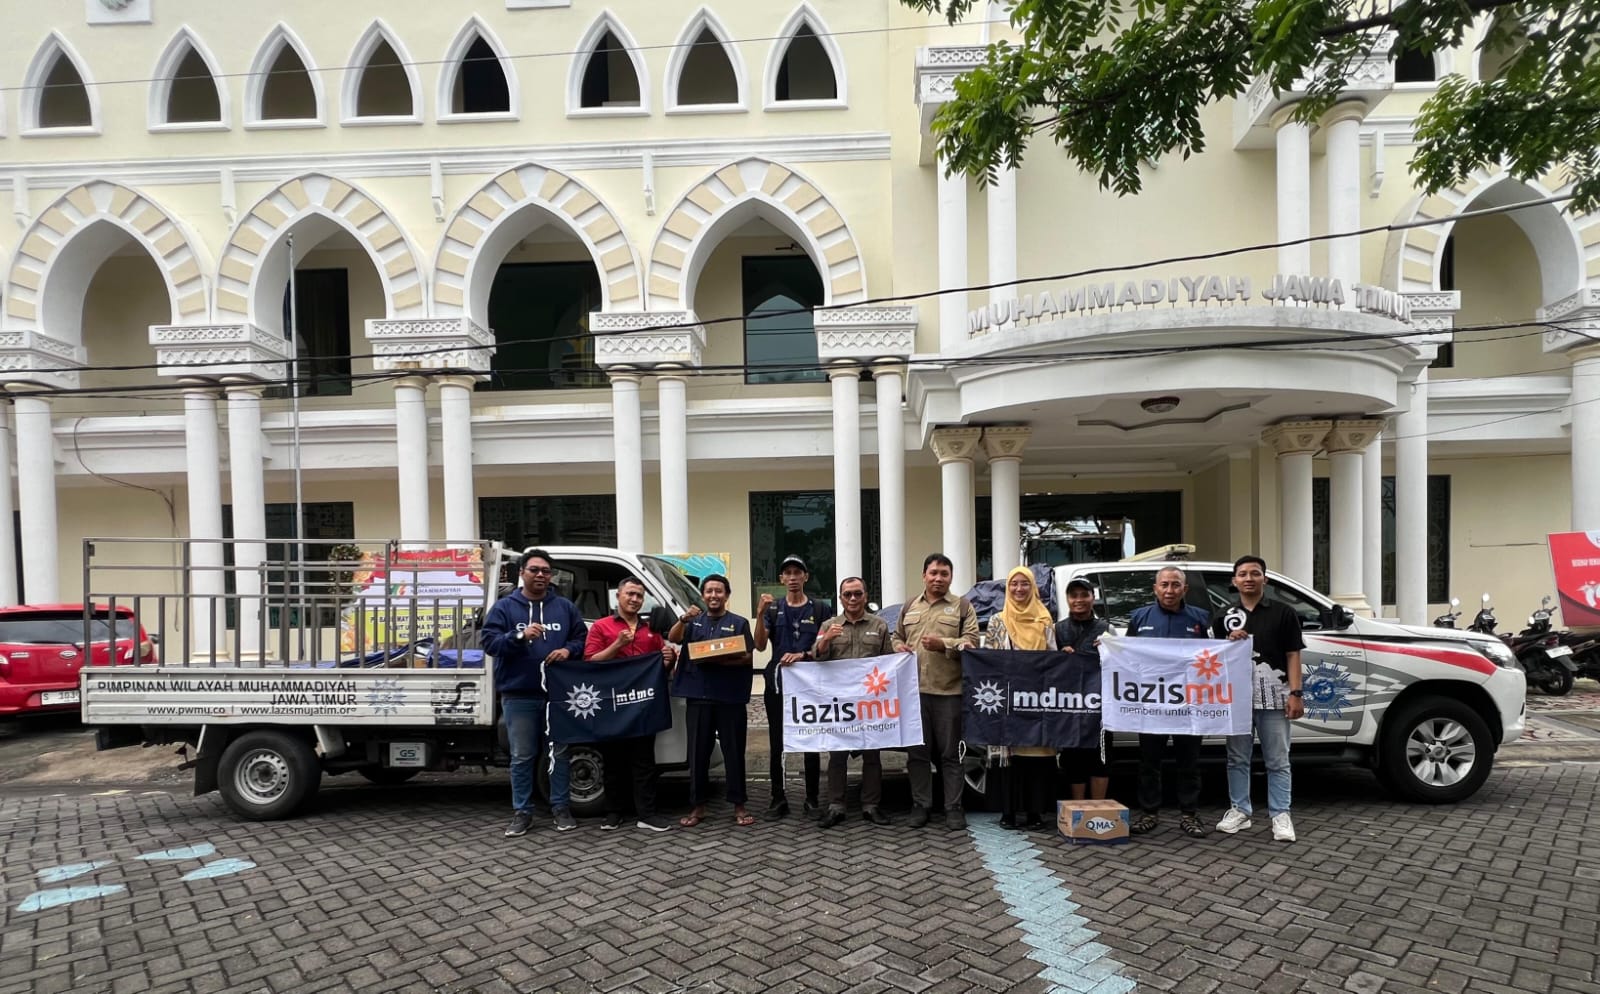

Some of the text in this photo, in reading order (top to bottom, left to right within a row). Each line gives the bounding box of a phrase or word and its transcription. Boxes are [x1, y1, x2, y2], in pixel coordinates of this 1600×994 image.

[968, 274, 1411, 333] MUHAMMADIYAH JAWA TIMUR
[98, 681, 356, 692] PIMPINAN WILAYAH MUHAMMADIYAH
[1113, 672, 1233, 704] lazismu
[43, 693, 49, 701] S
[270, 694, 357, 705] JAWA TIMUR
[616, 686, 655, 702] mdmc
[1013, 687, 1101, 709] mdmc
[147, 706, 225, 716] www.pwmu.co
[791, 696, 901, 724] lazismu
[1120, 705, 1229, 719] memberi untuk negeri
[840, 723, 865, 734] untuk
[867, 722, 897, 733] negeri
